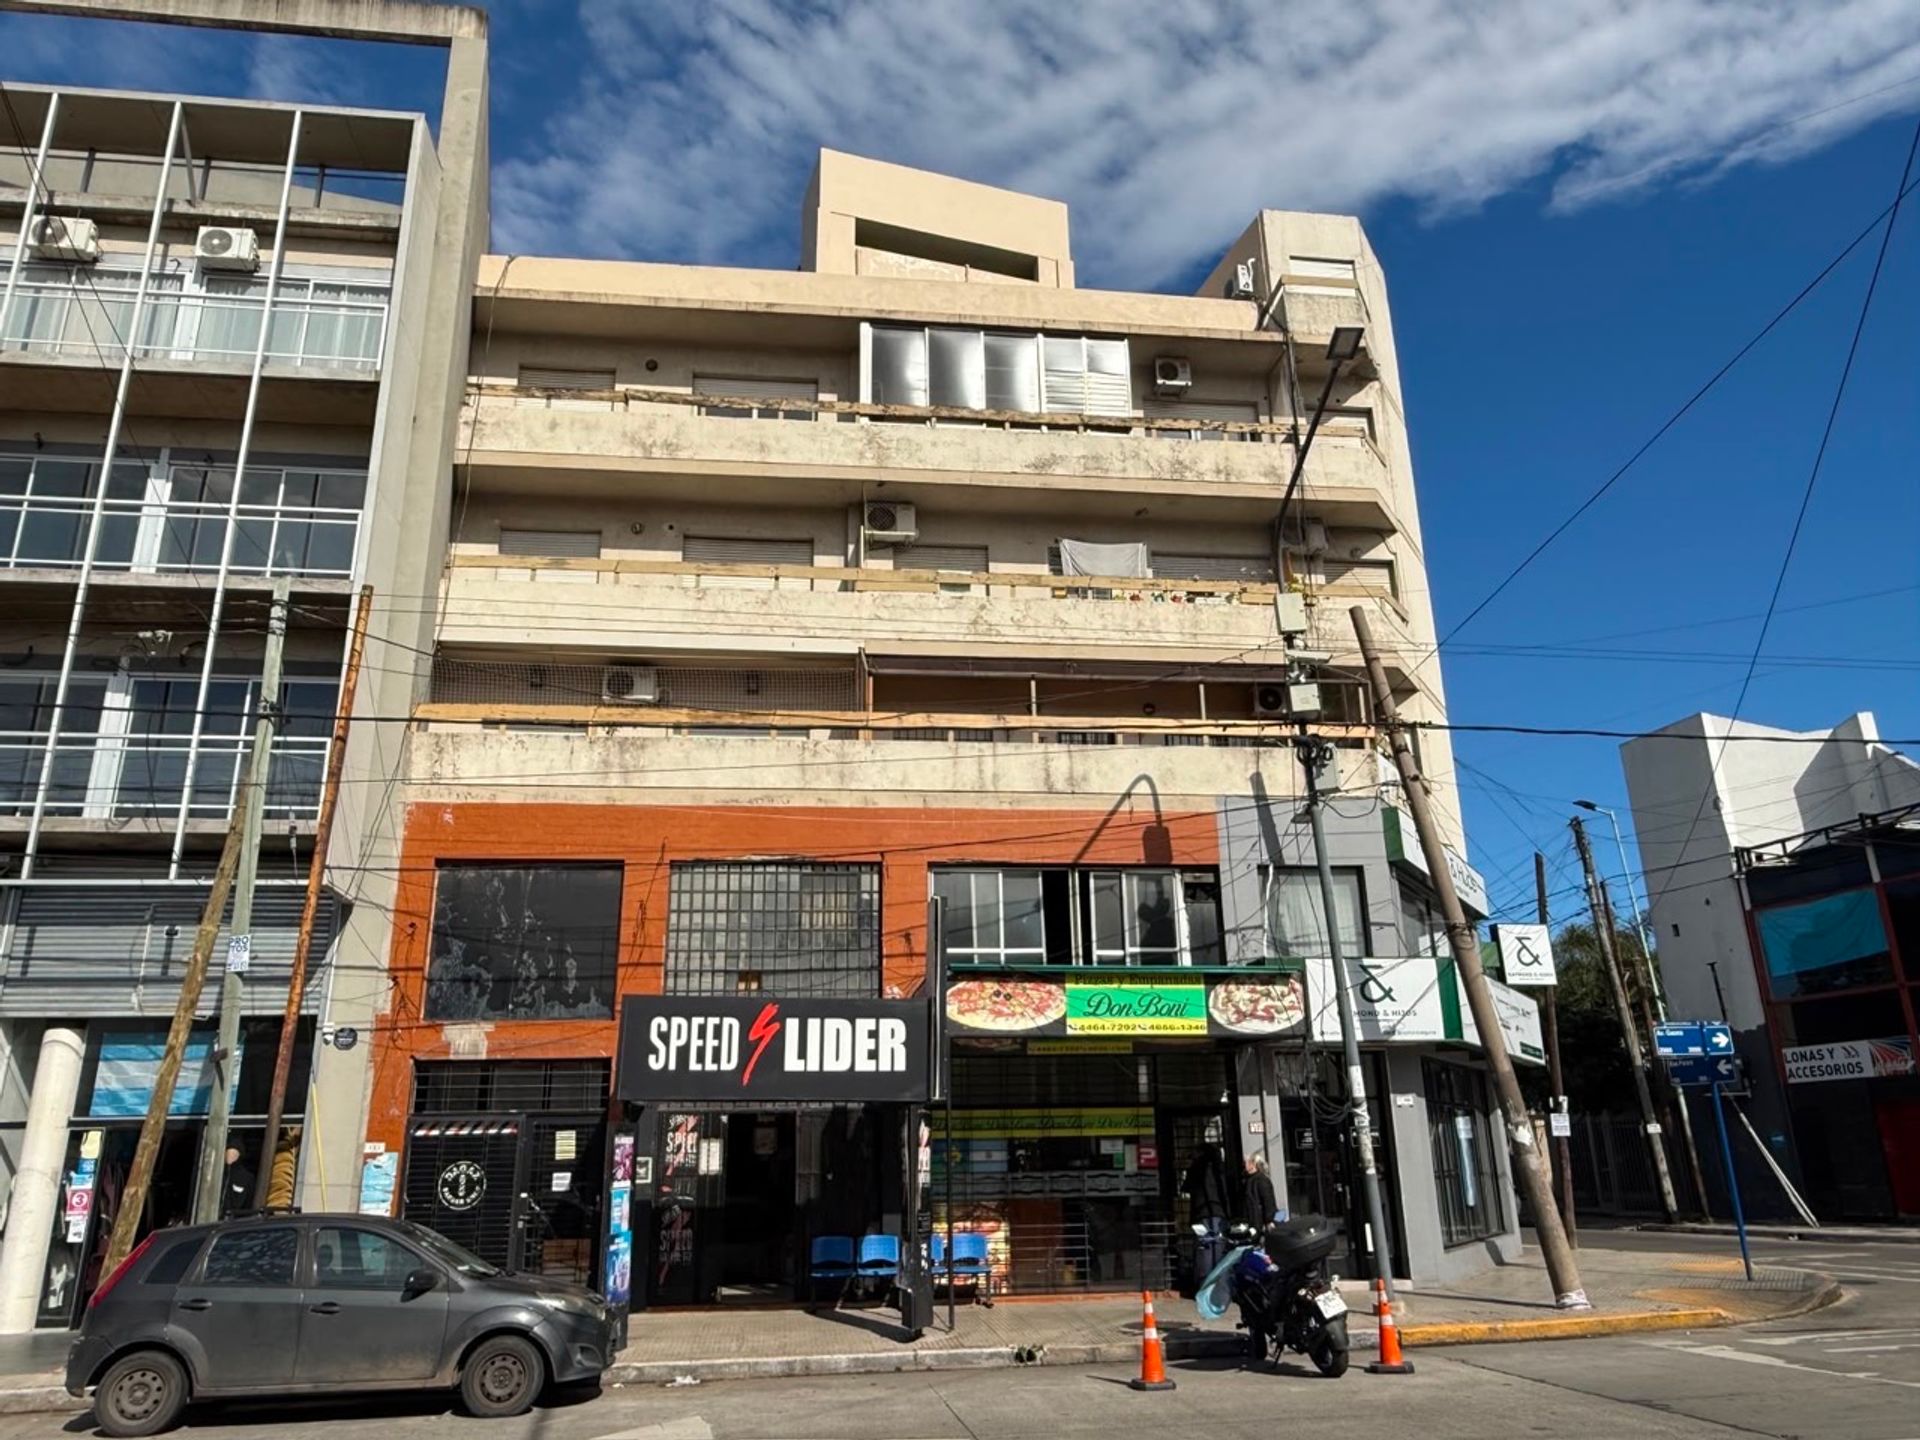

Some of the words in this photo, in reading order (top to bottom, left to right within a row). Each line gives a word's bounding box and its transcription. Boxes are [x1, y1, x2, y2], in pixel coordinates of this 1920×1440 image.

[1083, 991, 1133, 1017] Don
[1133, 991, 1187, 1017] Boni
[648, 1016, 740, 1071] SPEED
[784, 1017, 907, 1072] LIDER
[1785, 1048, 1824, 1064] LONAS
[1827, 1047, 1835, 1060] Y
[1788, 1062, 1865, 1080] ACCESORIOS
[75, 1194, 85, 1206] 3
